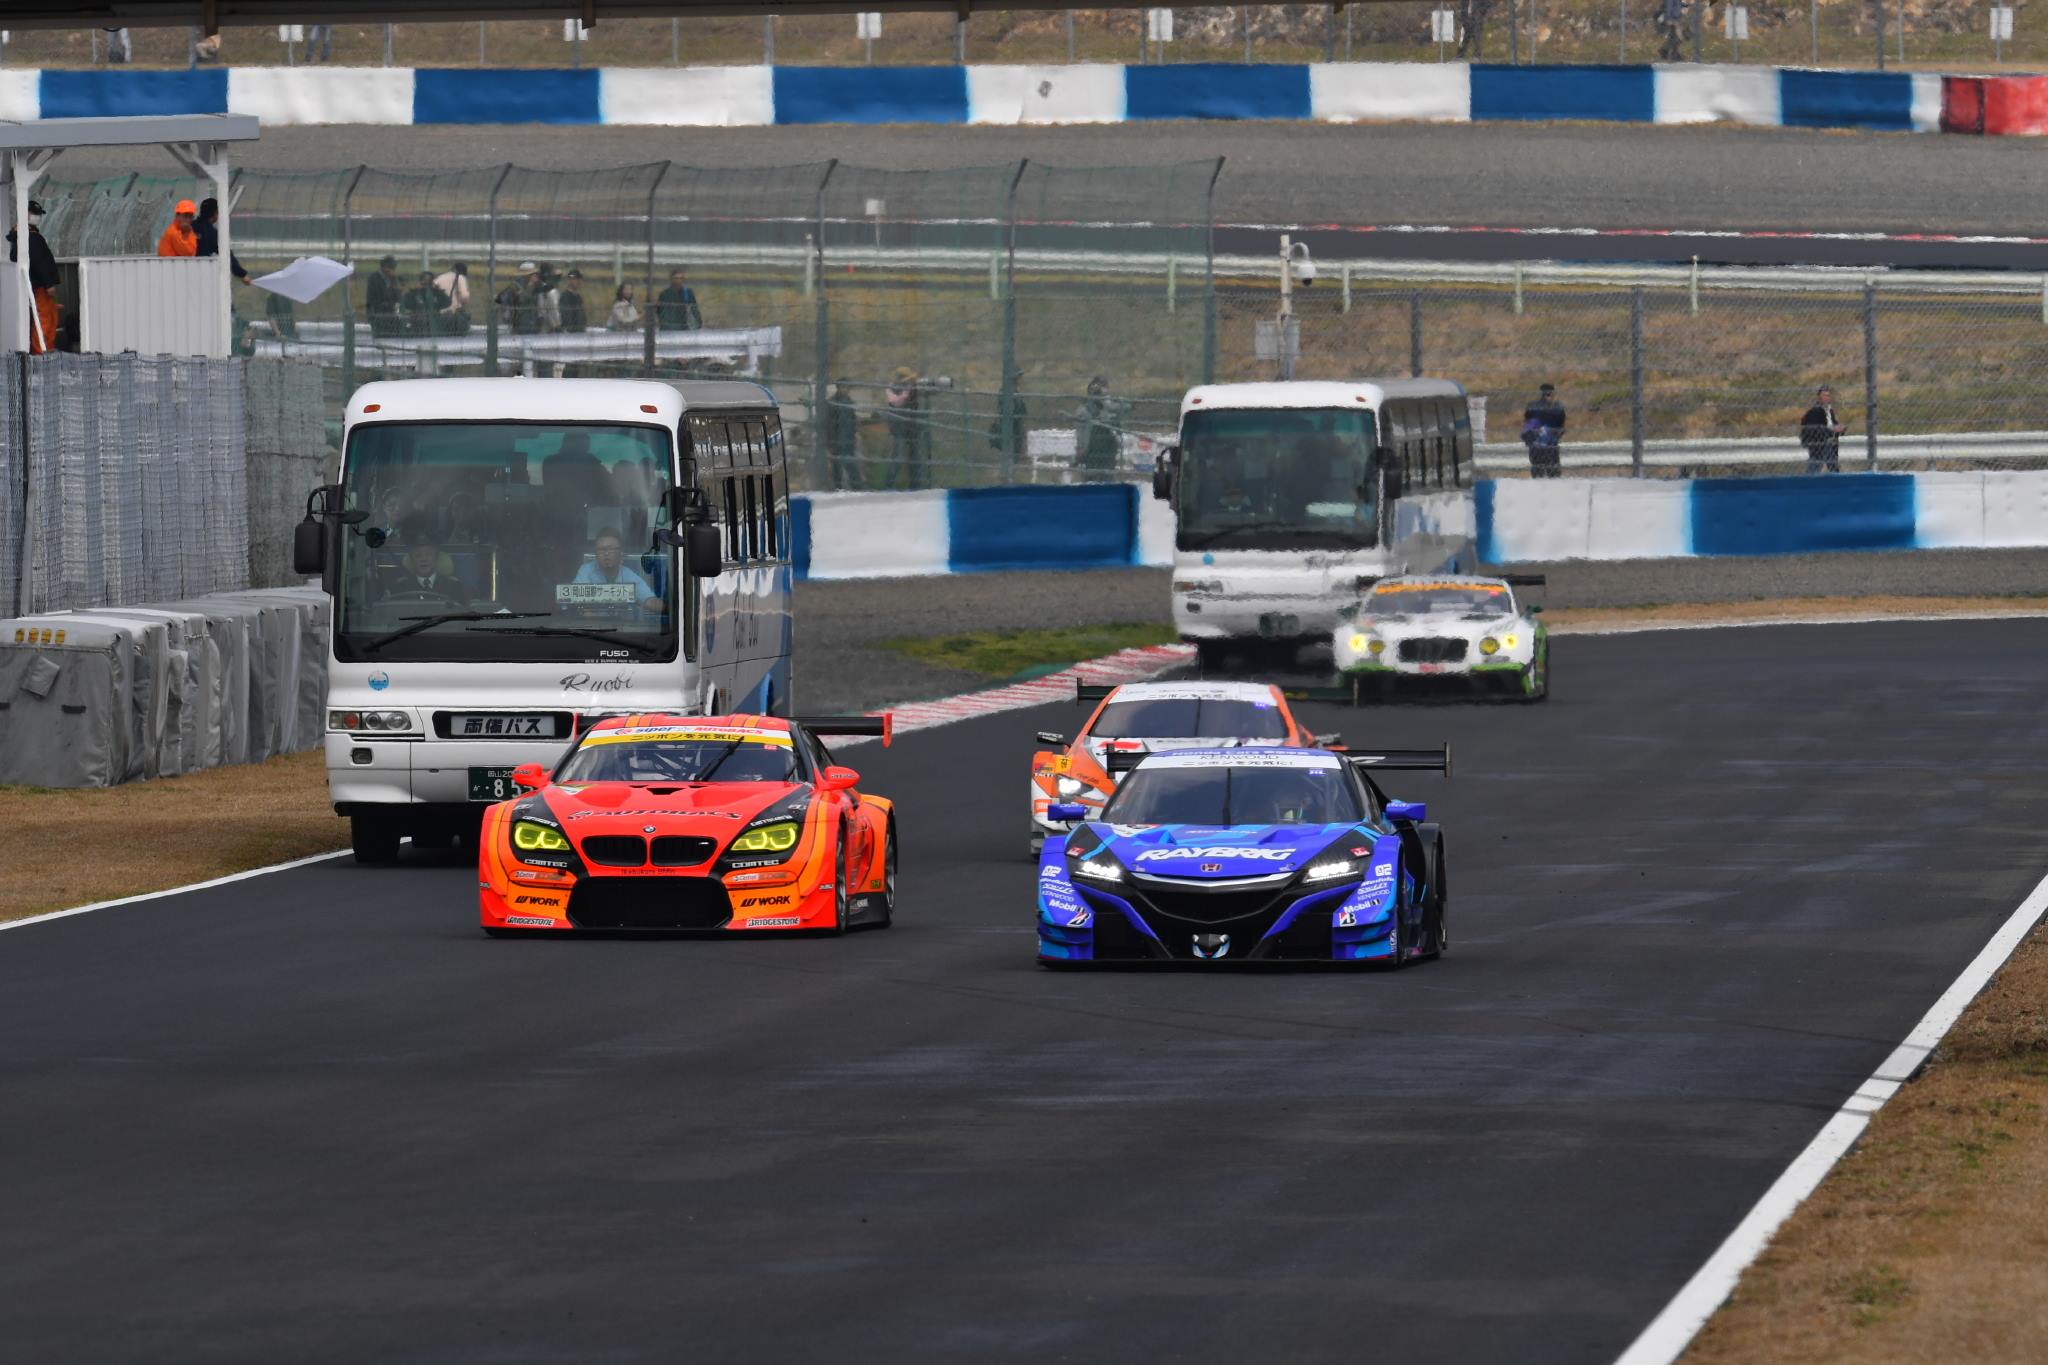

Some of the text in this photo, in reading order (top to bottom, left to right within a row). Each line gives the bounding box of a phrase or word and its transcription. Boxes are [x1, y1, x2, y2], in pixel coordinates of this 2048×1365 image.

[560, 668, 635, 692] Ryobi
[1135, 846, 1297, 861] RAYBRIG
[524, 859, 568, 868] COMTEC
[731, 859, 780, 869] COMTEC
[530, 897, 561, 906] WORK
[759, 895, 791, 906] WORK
[1049, 899, 1078, 912] Mobil
[1344, 901, 1371, 914] Mobil
[508, 917, 554, 926] BRIDGESTONE
[748, 918, 800, 927] BRIDGESTONE
